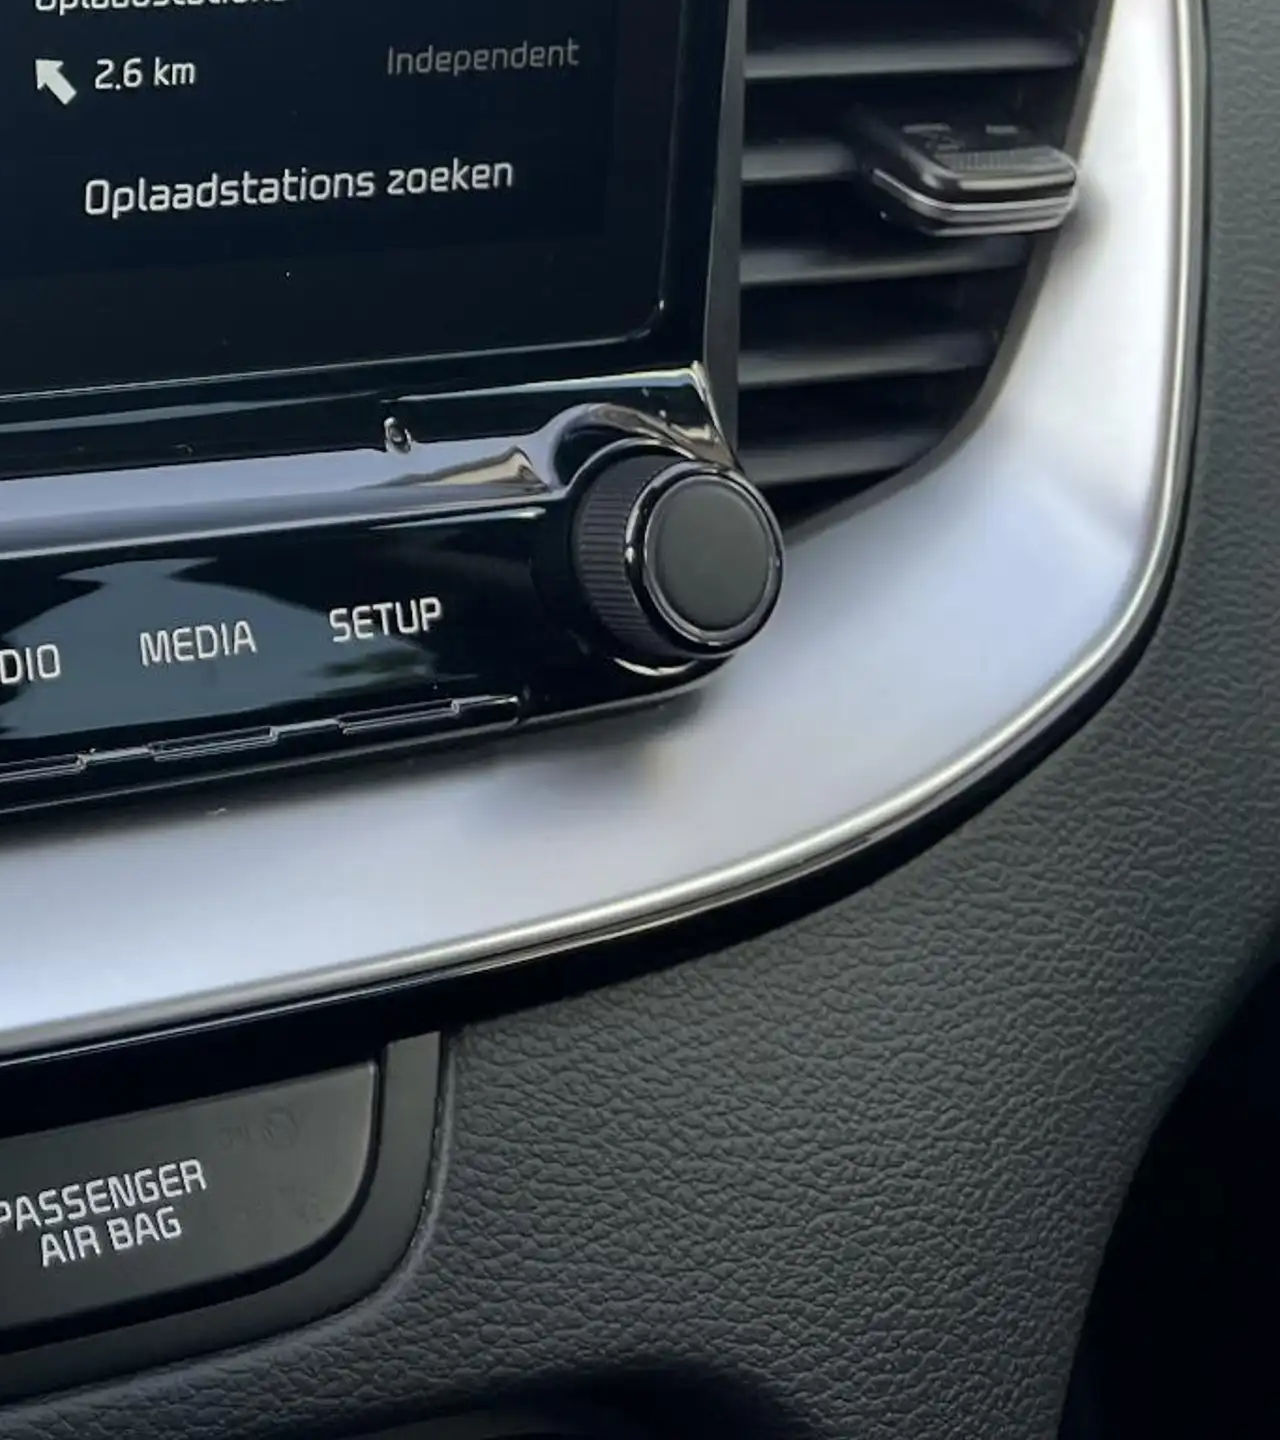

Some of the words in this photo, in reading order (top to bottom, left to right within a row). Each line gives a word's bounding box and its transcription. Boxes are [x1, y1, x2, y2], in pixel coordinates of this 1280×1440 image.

[94, 57, 143, 90] 2.6
[154, 56, 196, 86] km
[387, 37, 580, 77] Independent
[85, 167, 375, 220] Oplaadstations
[387, 157, 513, 195] zoeken
[139, 620, 257, 666] MEDIA
[329, 596, 442, 644] SETUP
[41, 1226, 103, 1268] AIR
[106, 1205, 184, 1252] BAG
